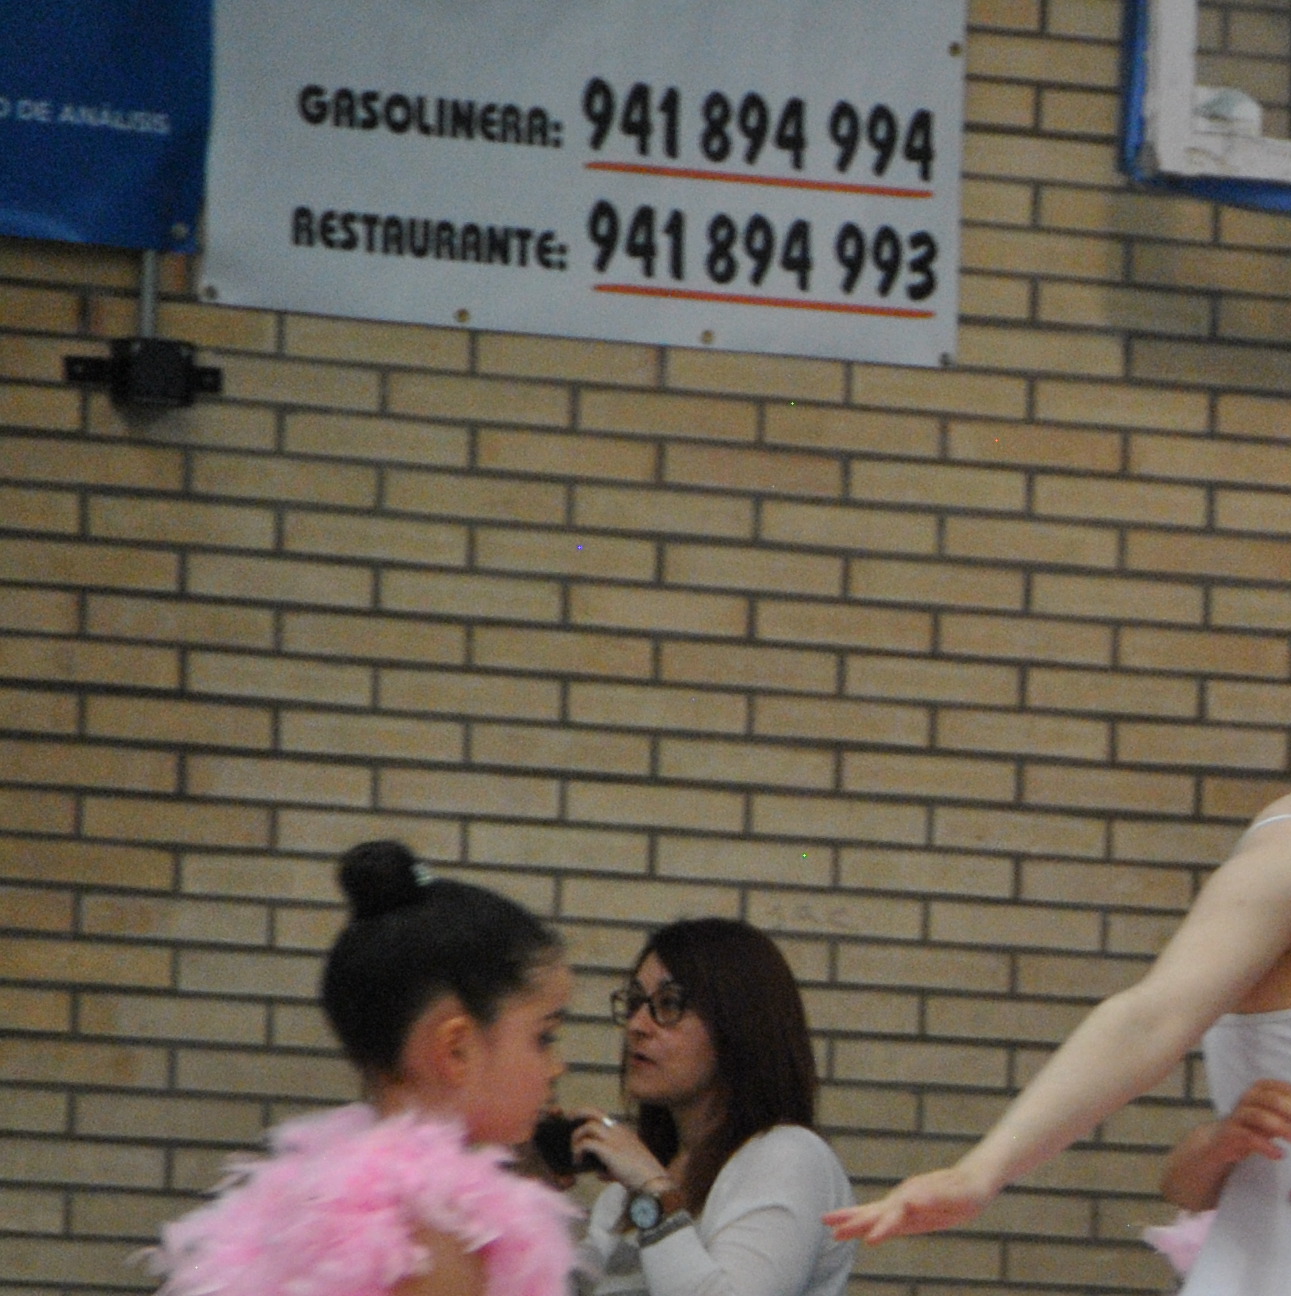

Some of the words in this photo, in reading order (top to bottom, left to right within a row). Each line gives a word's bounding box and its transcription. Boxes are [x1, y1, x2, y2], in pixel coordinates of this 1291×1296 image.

[15, 98, 50, 121] DE
[298, 84, 563, 148] GASOLINERA:
[582, 77, 681, 159] 941
[700, 91, 807, 171] 894
[828, 101, 936, 182] 994
[291, 206, 567, 271] RESTAURANTE:
[588, 199, 685, 281] 941
[706, 214, 813, 291] 894
[836, 223, 939, 303] 993
